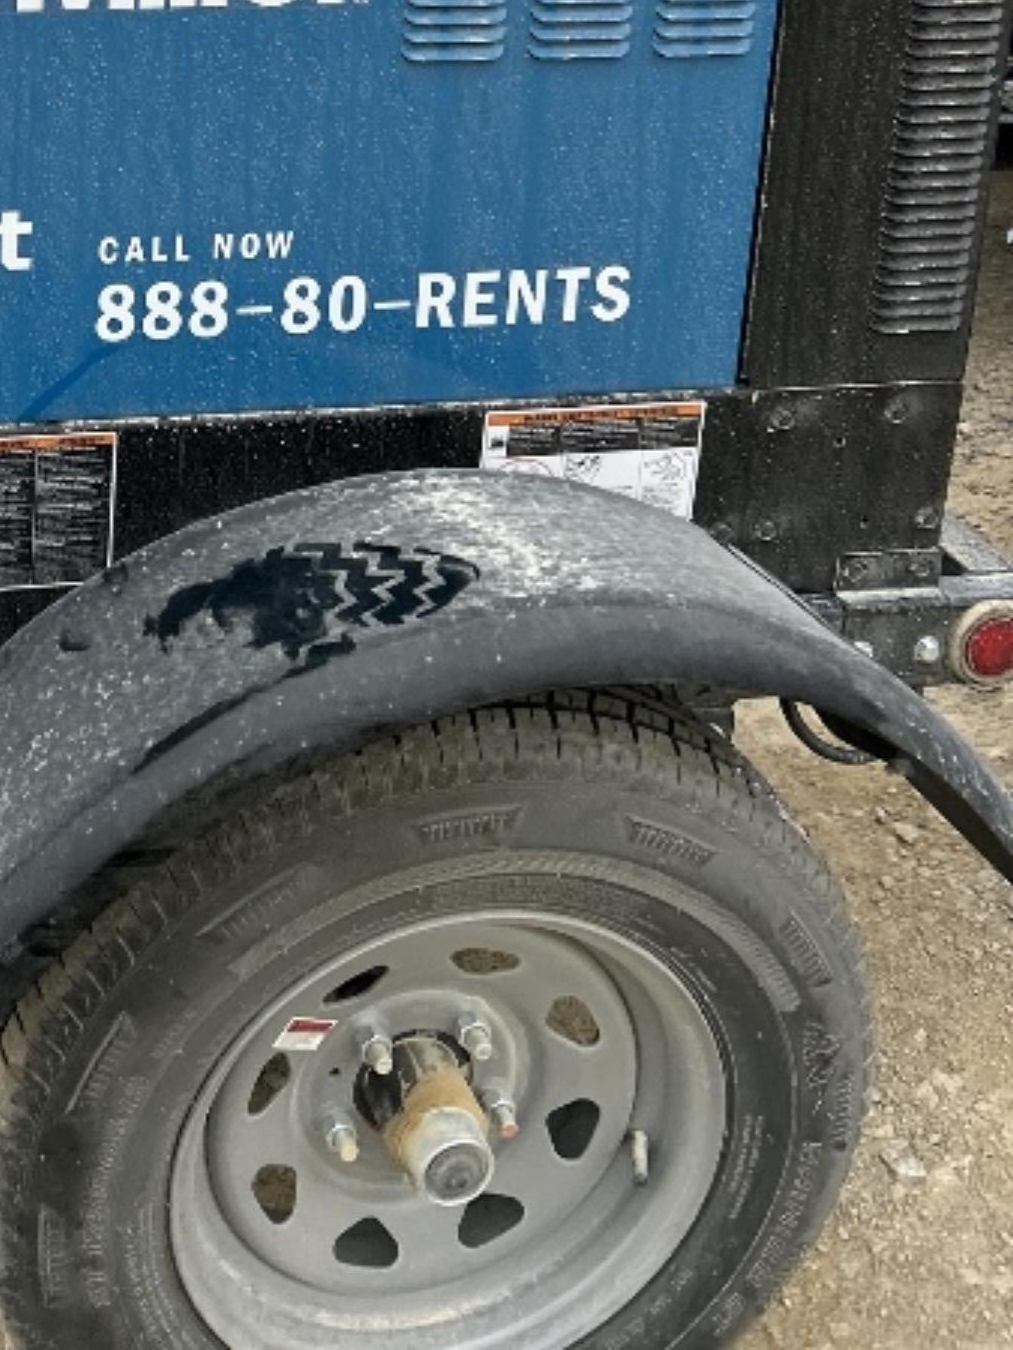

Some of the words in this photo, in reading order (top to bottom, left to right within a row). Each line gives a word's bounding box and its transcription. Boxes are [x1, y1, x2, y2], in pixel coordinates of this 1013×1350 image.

[97, 236, 191, 264] CALL
[213, 231, 295, 259] NOW
[95, 265, 632, 342] 888-80-RENTS
